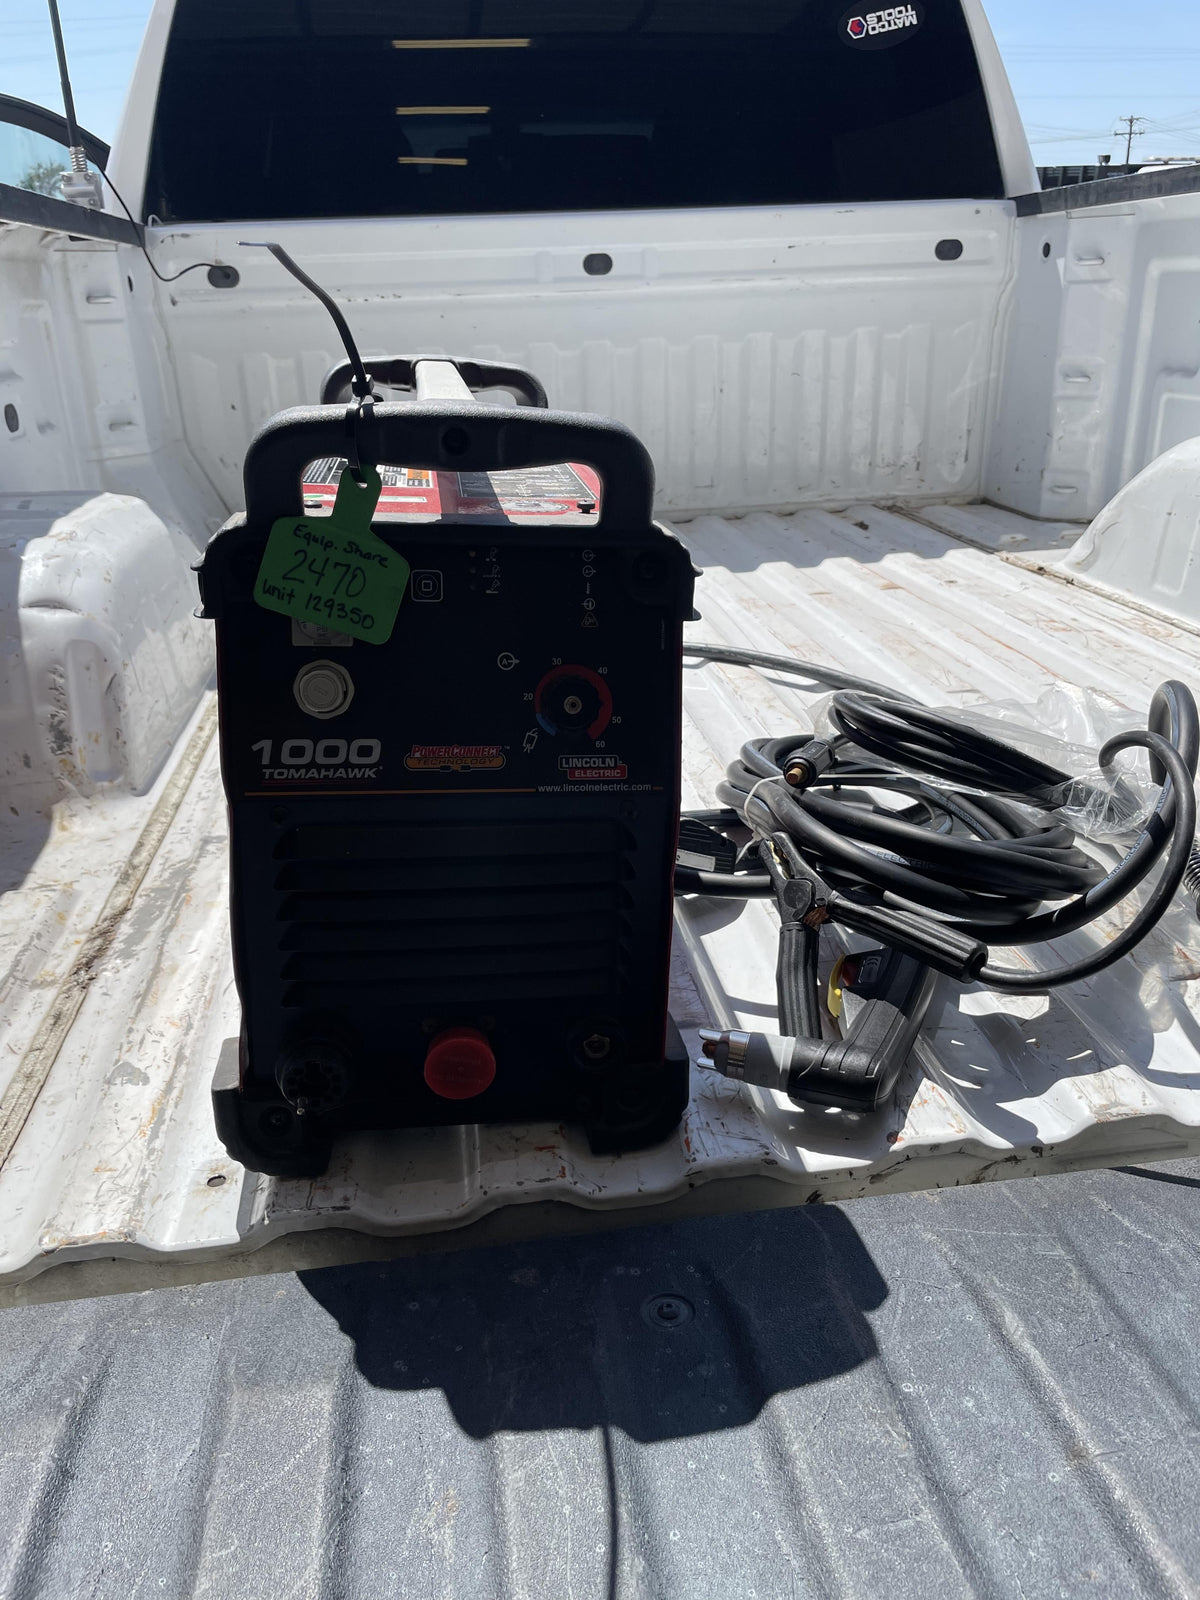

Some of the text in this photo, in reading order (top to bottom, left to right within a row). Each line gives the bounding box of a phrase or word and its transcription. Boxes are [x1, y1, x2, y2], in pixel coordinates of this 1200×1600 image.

[866, 4, 916, 24] TOOLS
[868, 14, 918, 35] MATCO
[293, 524, 389, 568] Equip. Share
[282, 549, 366, 597] 2470
[305, 593, 375, 629] 129350
[251, 738, 382, 765] 1000
[417, 758, 495, 766] TECHNOLOGY
[562, 758, 615, 767] LINCOLN
[262, 767, 378, 779] TOMAHAWK
[574, 769, 621, 777] ELECTRIC
[537, 783, 652, 792] www.lincolnelectric.com
